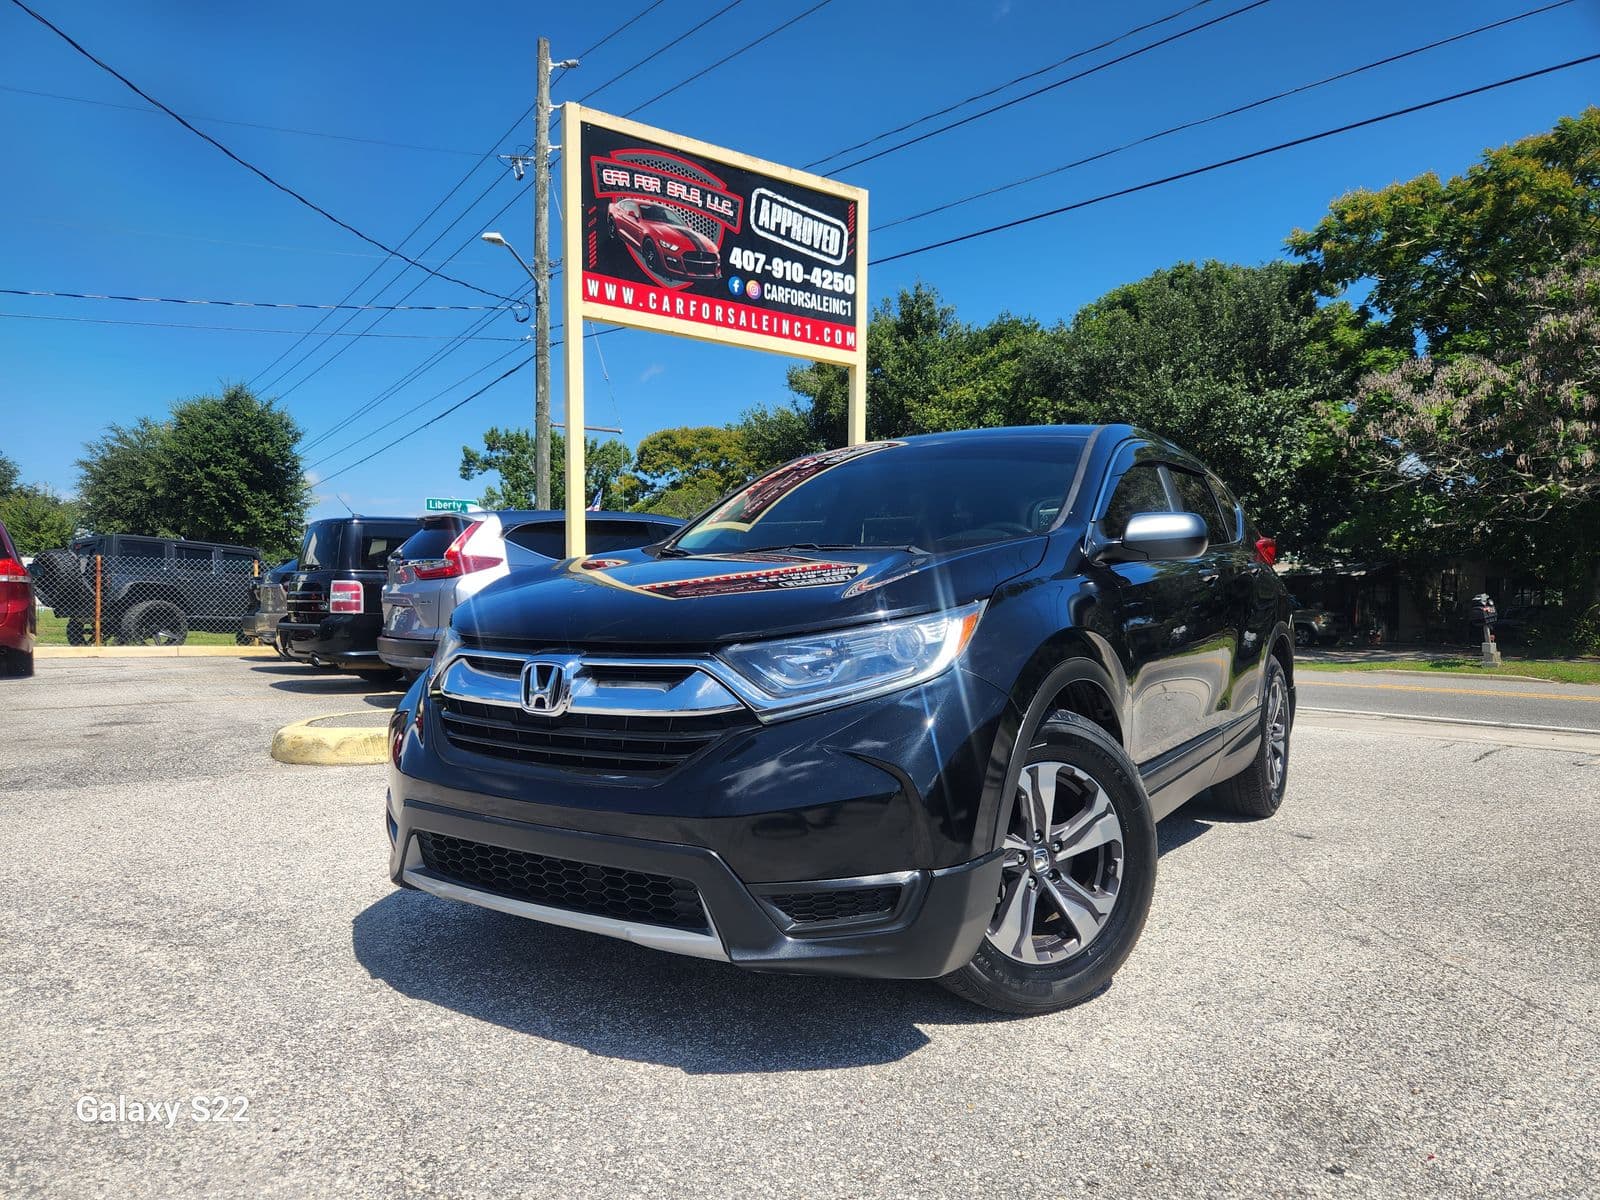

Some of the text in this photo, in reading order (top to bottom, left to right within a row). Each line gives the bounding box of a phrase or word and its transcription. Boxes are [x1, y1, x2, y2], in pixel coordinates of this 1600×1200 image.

[602, 169, 734, 217] CAR FOR SALE, LLC.
[758, 198, 841, 256] APPROVED
[729, 246, 856, 295] 407-910-4250
[587, 278, 855, 347] WWW.CARFORSALEINC1.COM
[764, 283, 852, 317] CARFORSALEINC1
[429, 500, 462, 511] Liberty
